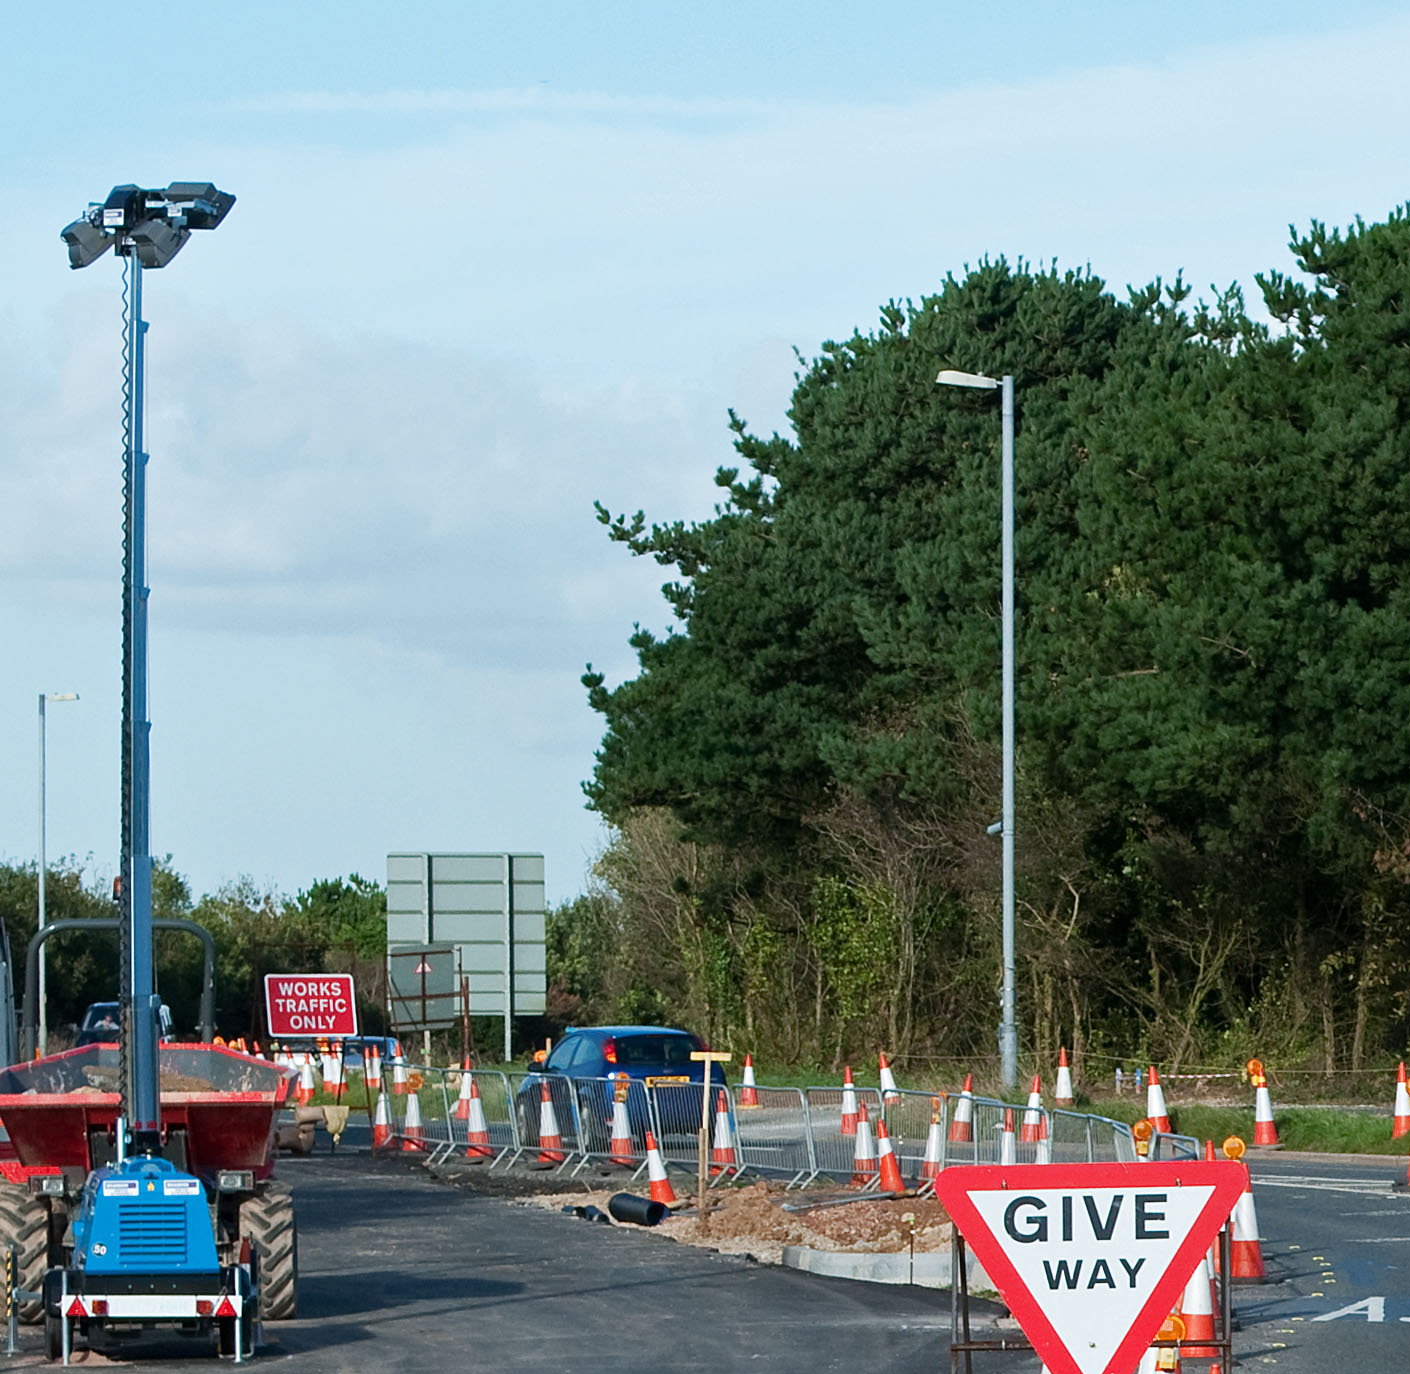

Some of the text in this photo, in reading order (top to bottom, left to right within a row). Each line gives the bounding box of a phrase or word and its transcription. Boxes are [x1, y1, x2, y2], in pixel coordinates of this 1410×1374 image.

[278, 981, 342, 996] WORKS
[275, 998, 347, 1013] TRAFFIC
[289, 1015, 336, 1030] ONLY
[1003, 1194, 1171, 1244] GIVE
[1042, 1258, 1147, 1291] WAY
